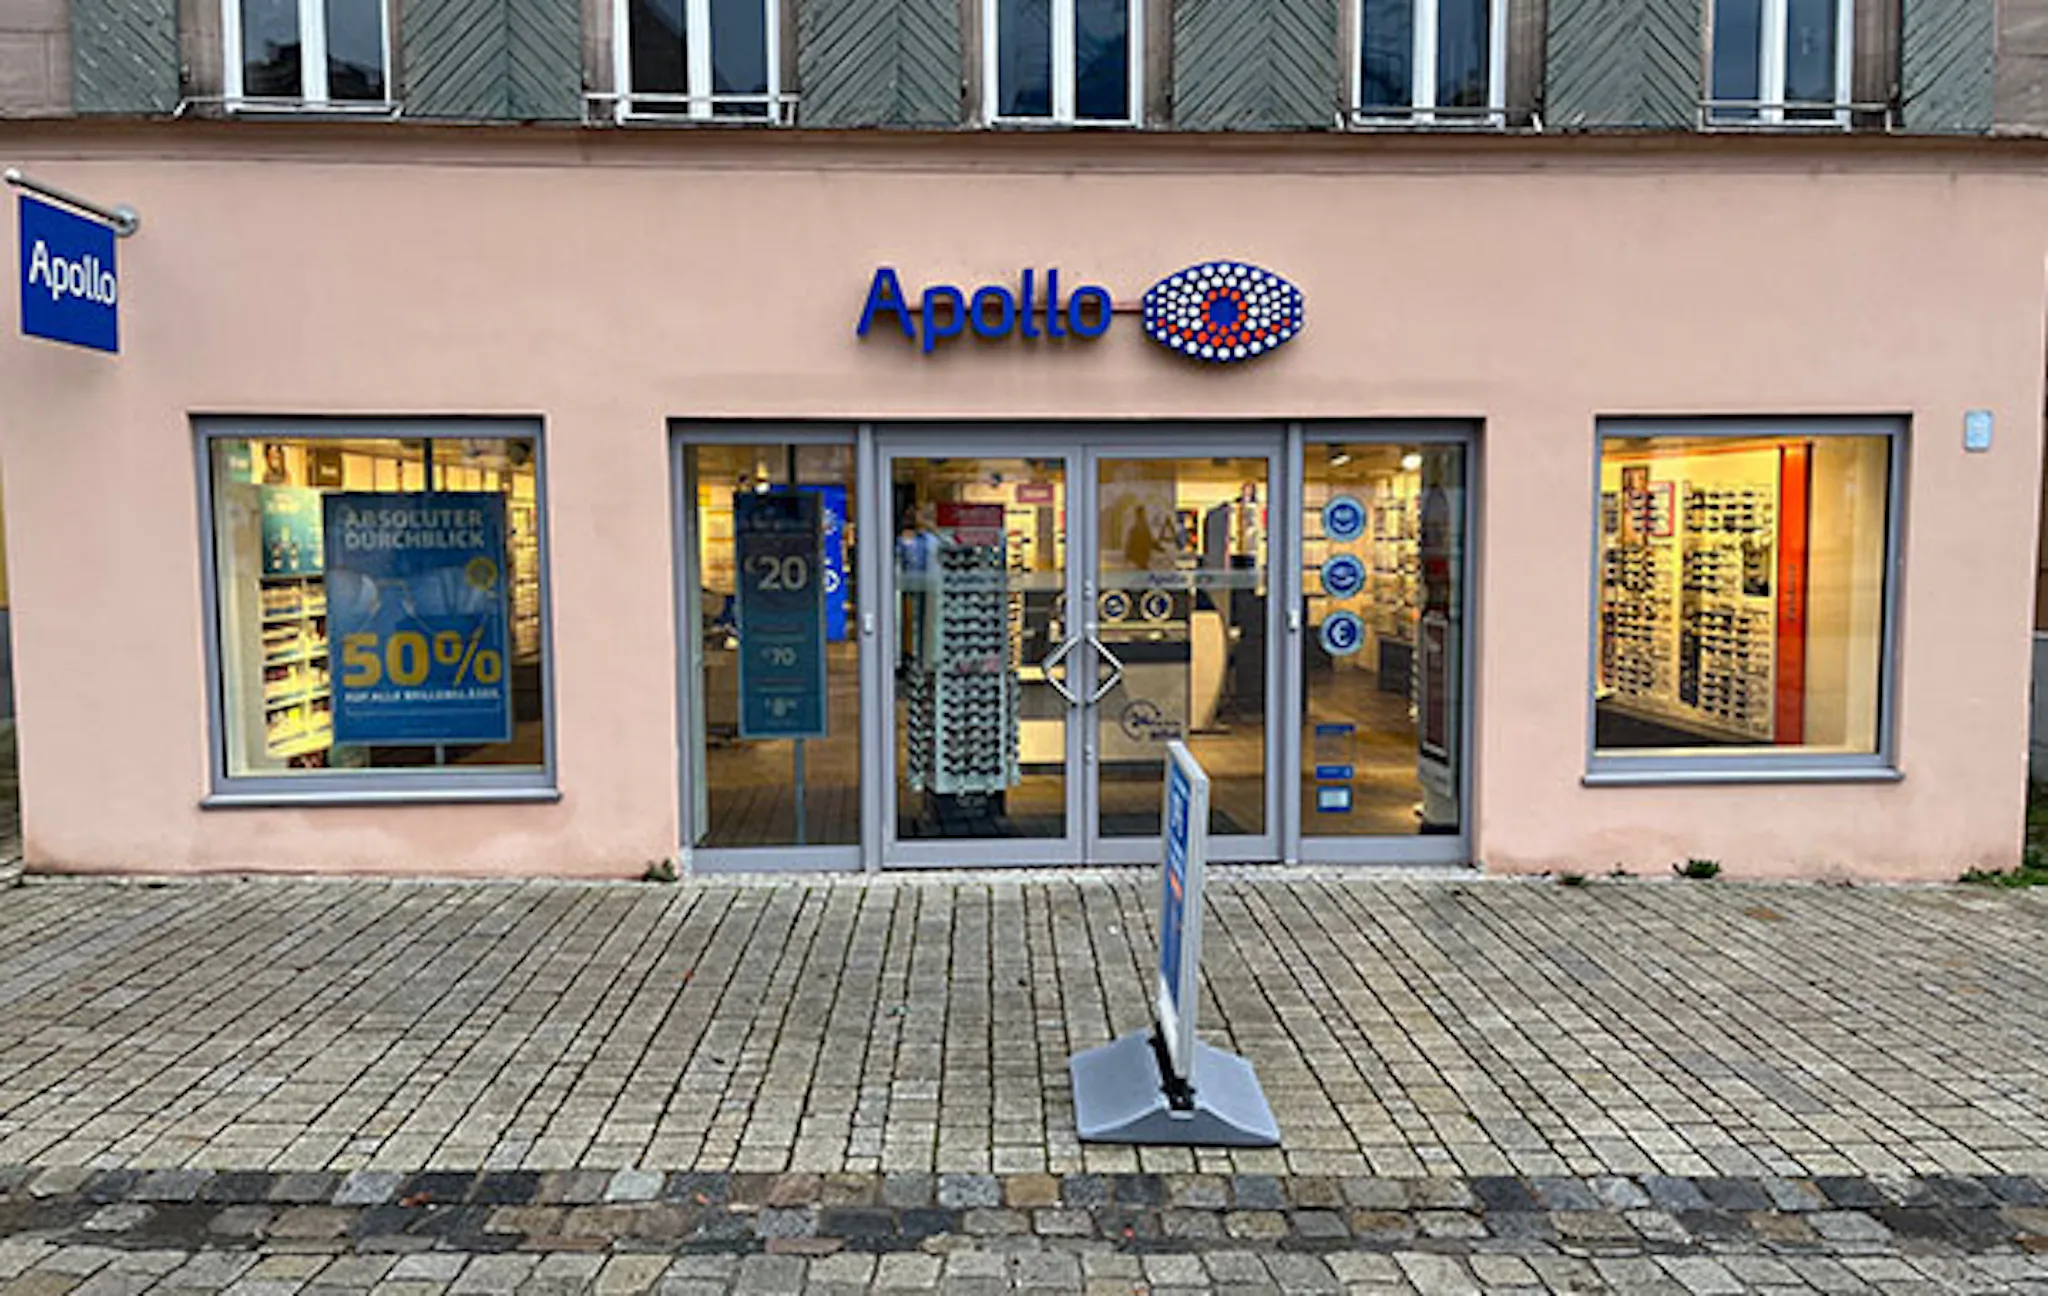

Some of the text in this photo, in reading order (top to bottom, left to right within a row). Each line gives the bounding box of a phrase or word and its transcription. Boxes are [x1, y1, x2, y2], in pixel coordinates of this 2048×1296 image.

[28, 239, 116, 305] Apollo
[857, 268, 1112, 353] Apollo
[343, 509, 483, 529] ABSOLUTER
[344, 529, 485, 550] DURCHBLICK
[342, 626, 502, 687] 50%
